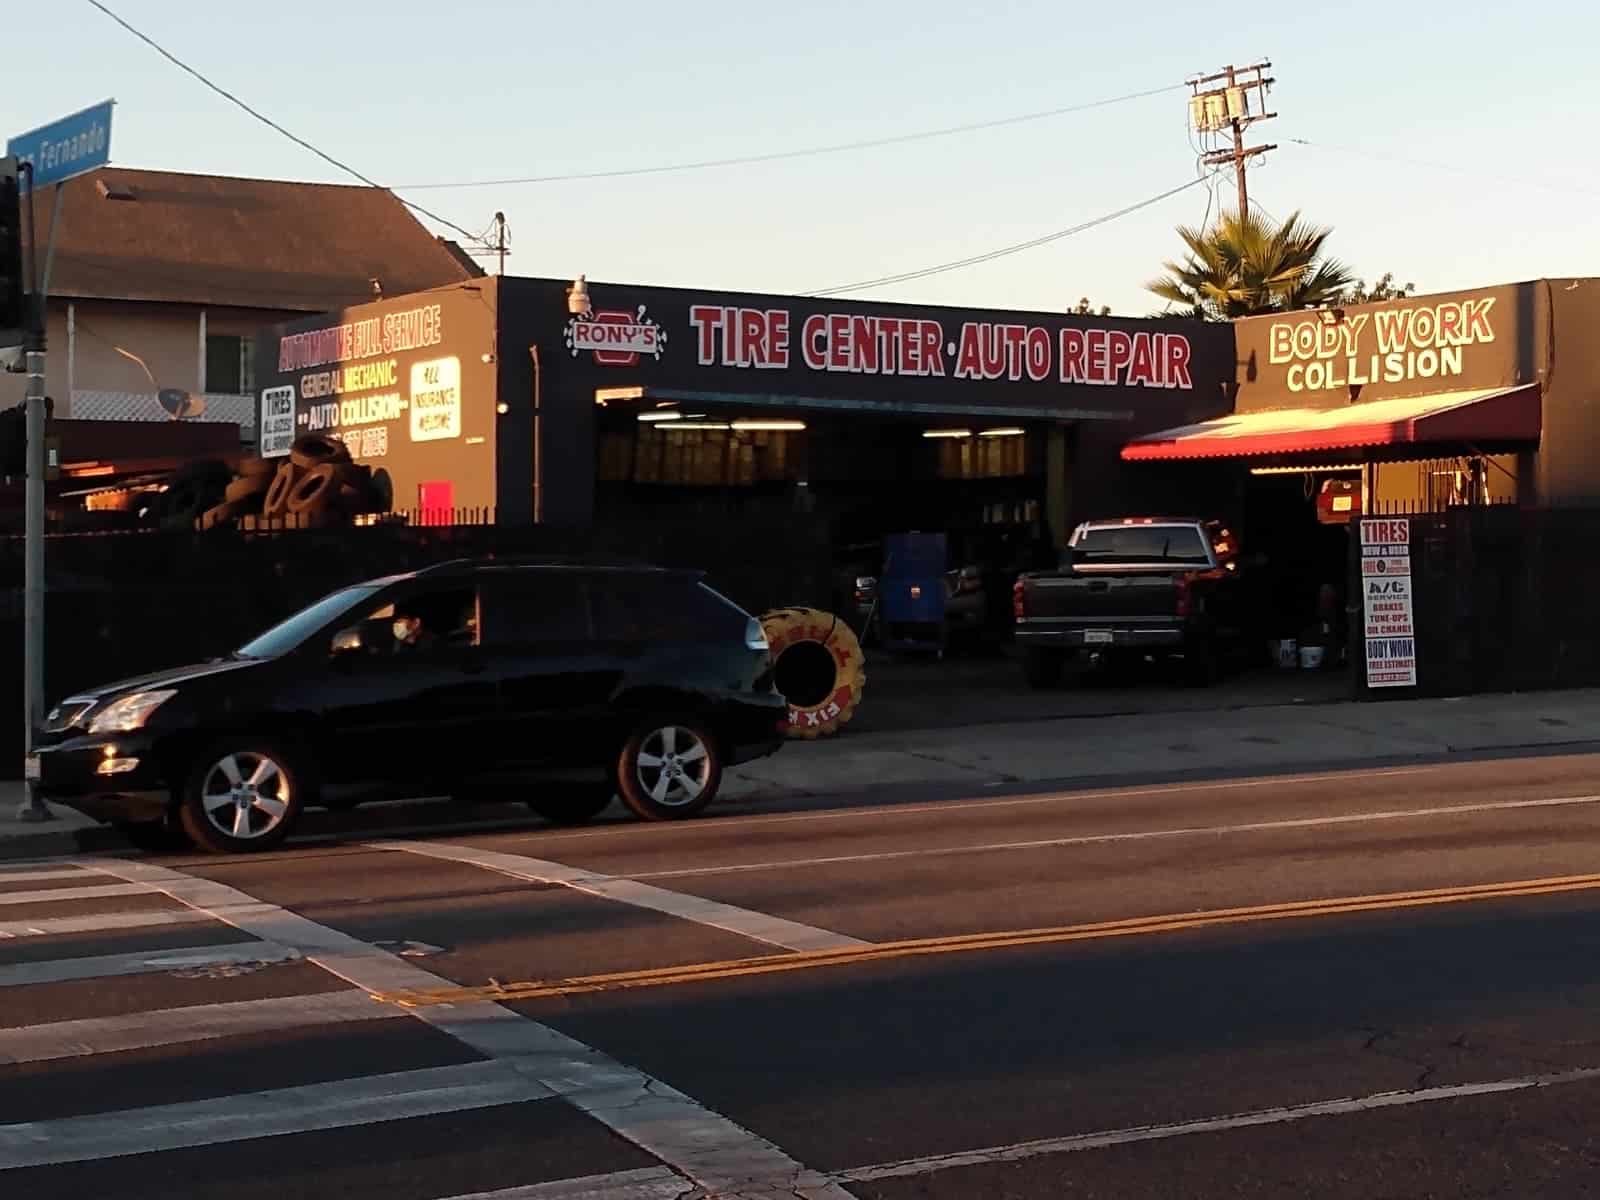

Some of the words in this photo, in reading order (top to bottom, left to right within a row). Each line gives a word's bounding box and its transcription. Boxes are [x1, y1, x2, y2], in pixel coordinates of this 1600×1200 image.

[38, 121, 104, 172] Fernando
[278, 324, 353, 373] AUTOMOTIVE
[353, 317, 383, 360] FULL
[383, 304, 441, 354] SERVICE
[575, 324, 655, 346] RONY'S
[1269, 313, 1369, 364] BODY
[1374, 298, 1496, 355] WORK
[690, 305, 789, 368] TIRE
[802, 314, 945, 377] CENTER
[953, 322, 1050, 381] AUTO
[1060, 328, 1193, 389] REPAIR
[301, 370, 344, 399] GENERAL
[344, 360, 398, 393] MECHANIC
[423, 366, 440, 385] ALL
[1287, 346, 1462, 392] COLLISION
[266, 390, 292, 417] TIRES
[308, 401, 340, 431] AUTO
[1362, 520, 1408, 543] TIRES
[1369, 581, 1405, 594] A/C
[1369, 613, 1409, 623] TUNE-UPS
[1373, 602, 1404, 612] BRAKES
[1367, 640, 1388, 659] BODY
[1389, 639, 1413, 658] WORK
[803, 701, 841, 728] FIX
